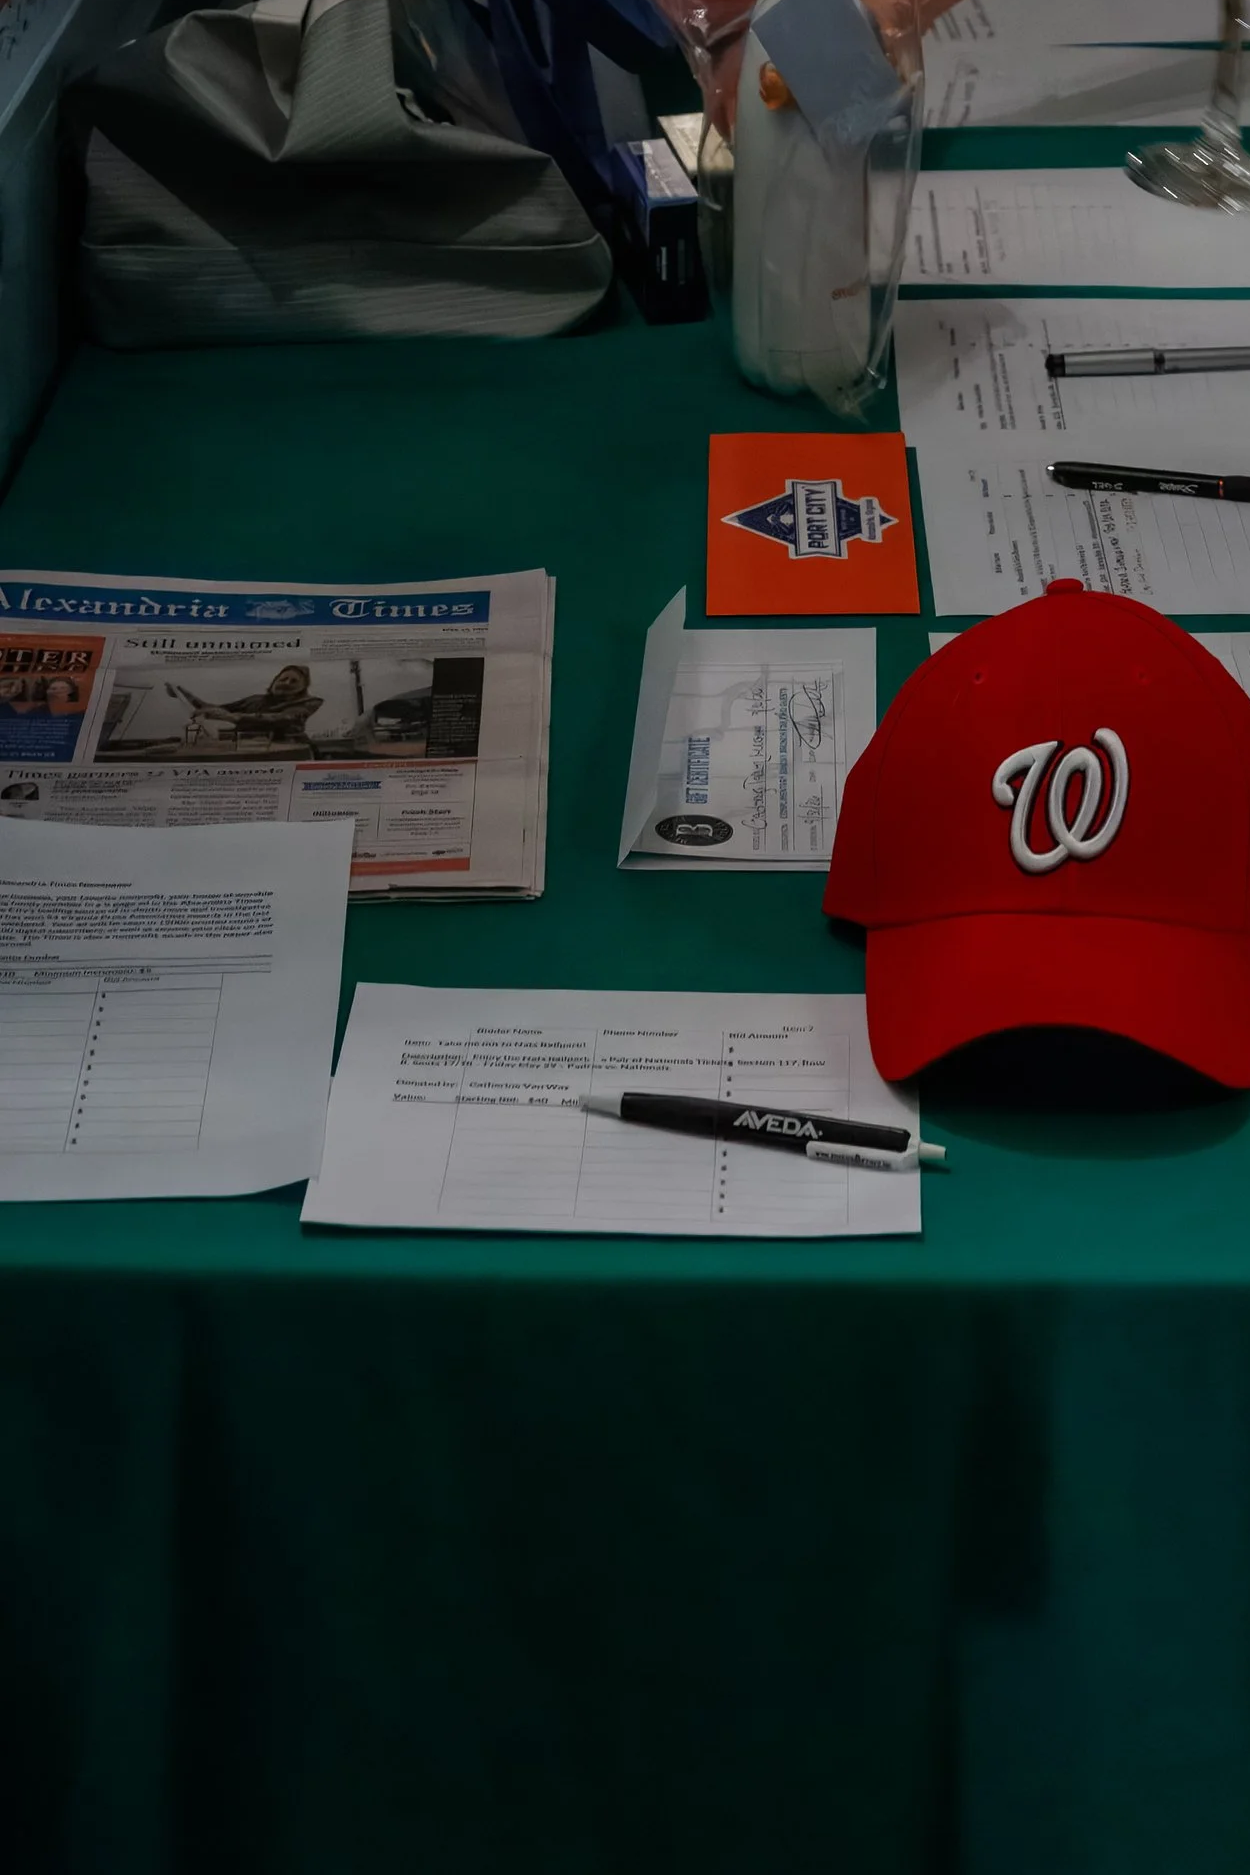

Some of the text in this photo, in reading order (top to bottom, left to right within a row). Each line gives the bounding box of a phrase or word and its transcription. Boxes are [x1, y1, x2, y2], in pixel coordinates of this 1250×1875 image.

[804, 487, 829, 548] PORT CITY
[328, 597, 475, 619] Times
[124, 637, 177, 650] Still
[184, 637, 301, 651] unnamed
[992, 726, 1131, 876] W
[732, 1109, 821, 1140] AVEDA
